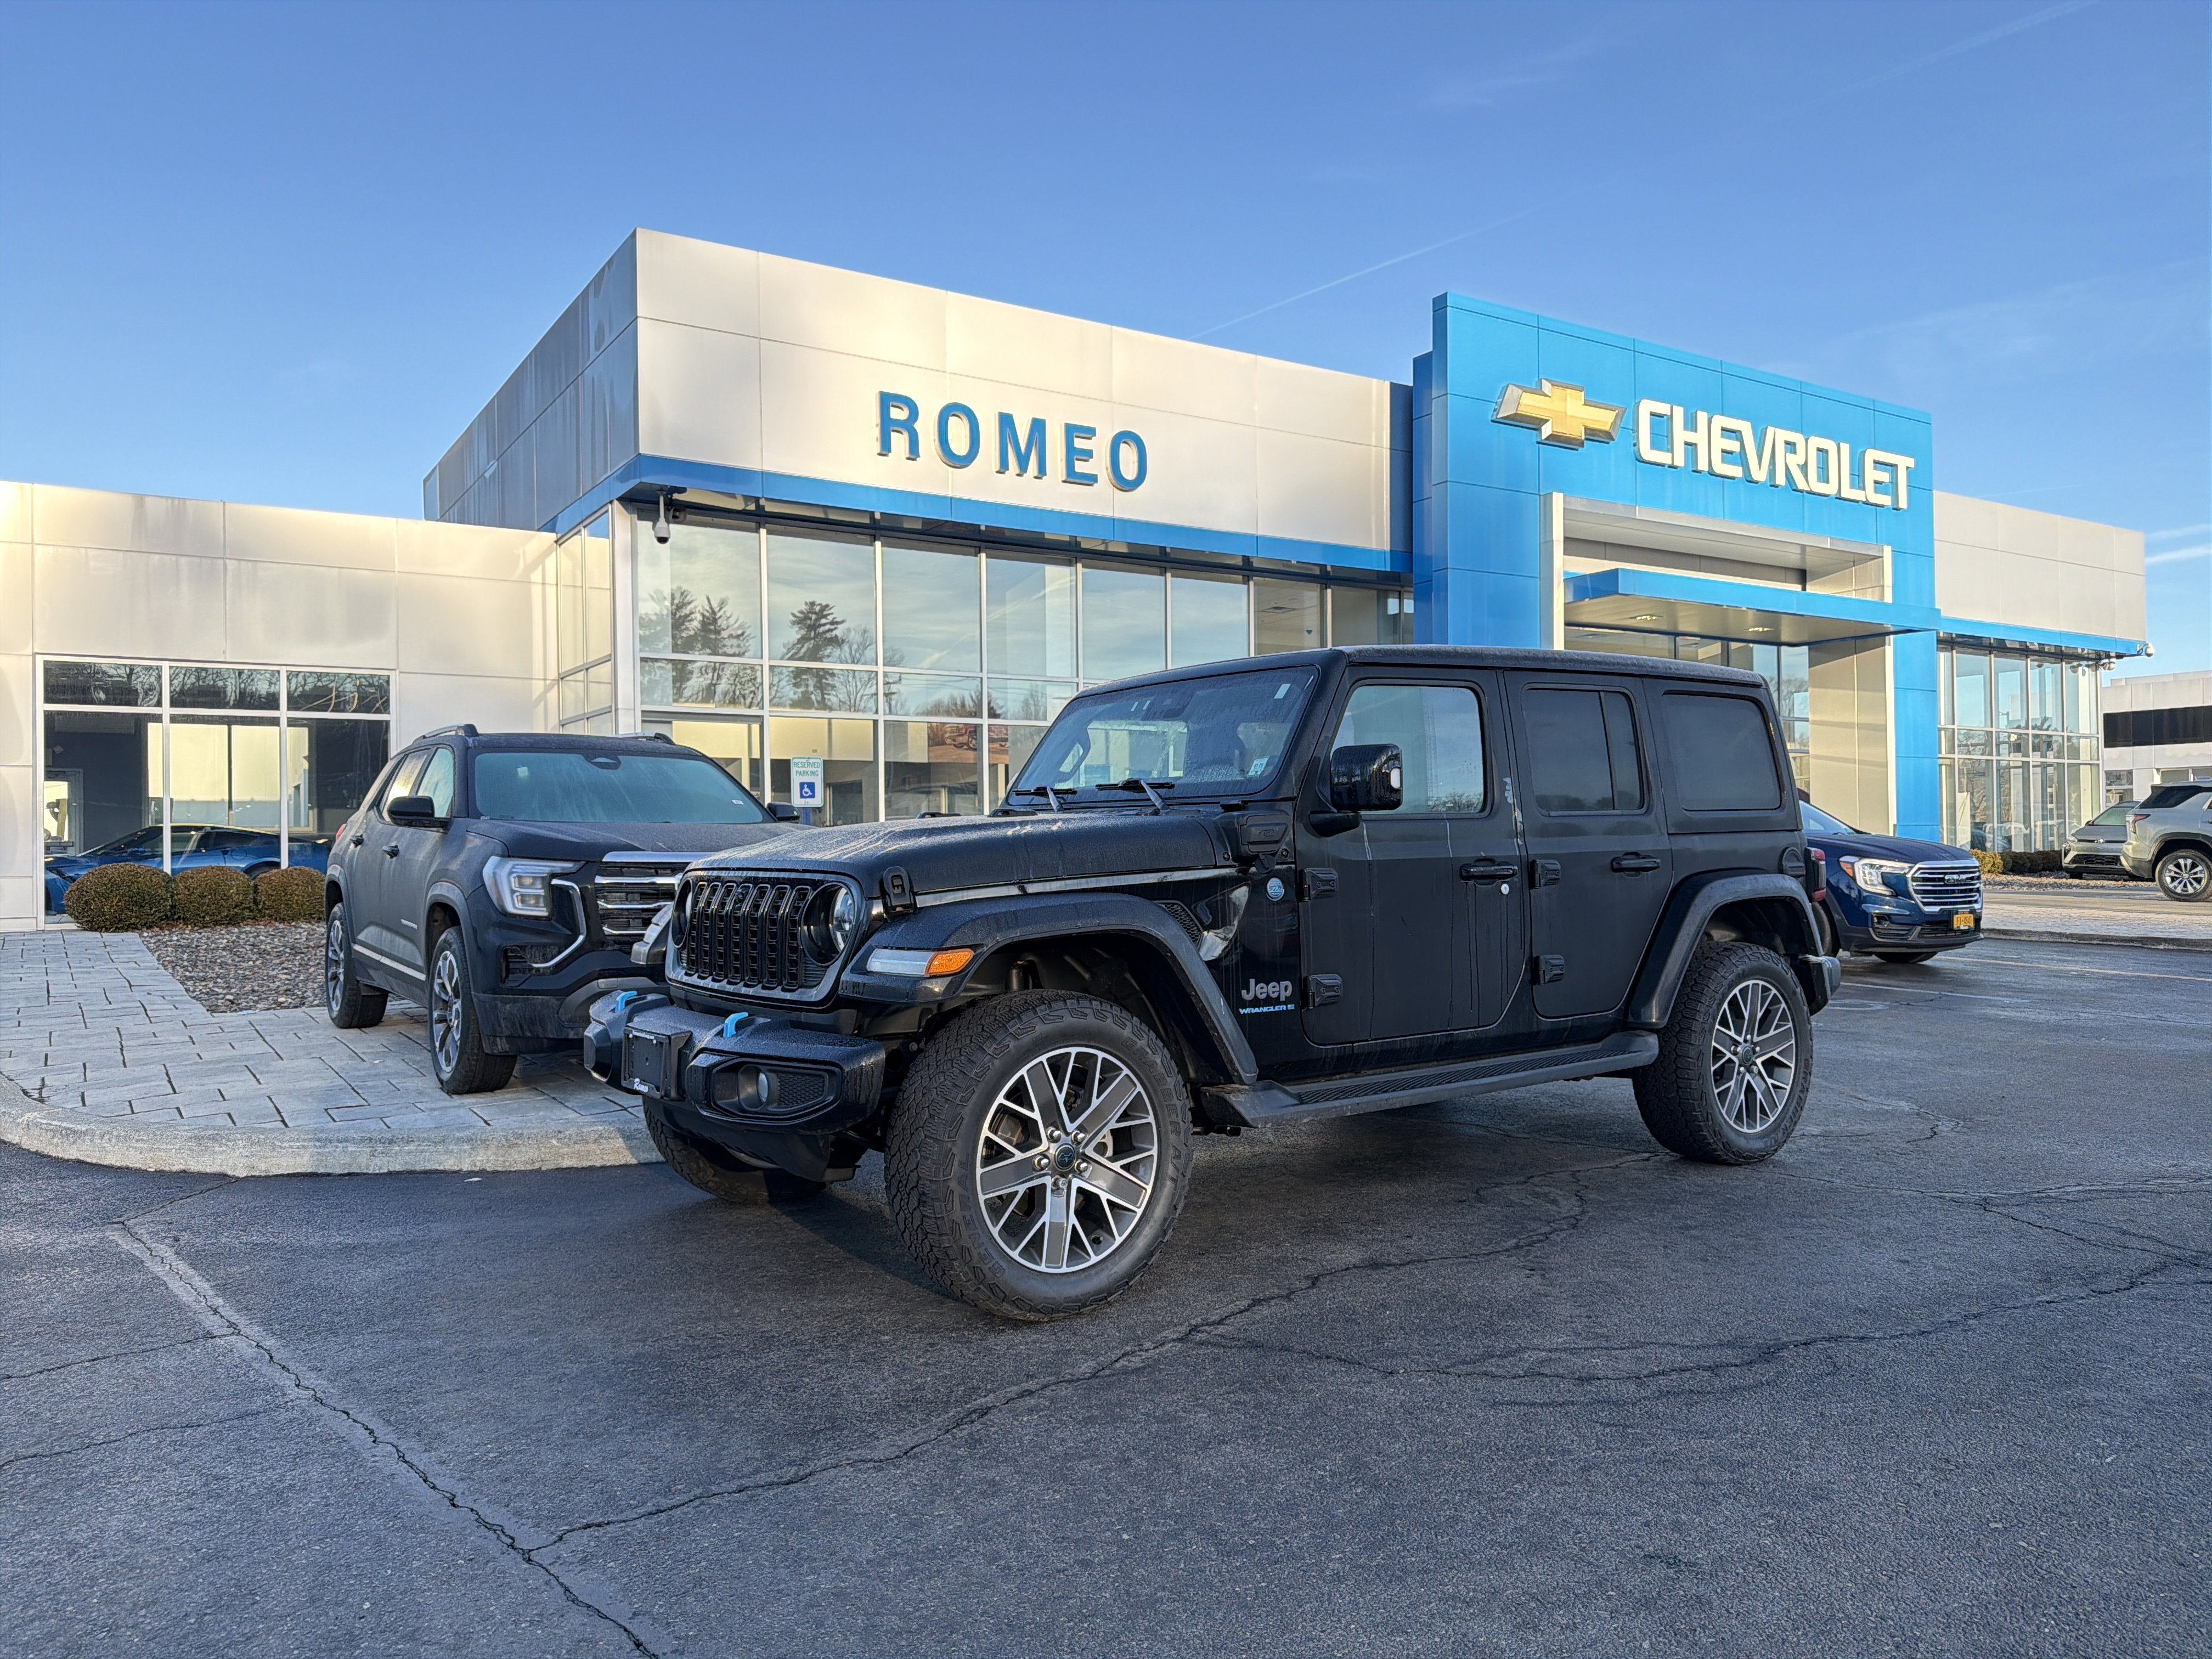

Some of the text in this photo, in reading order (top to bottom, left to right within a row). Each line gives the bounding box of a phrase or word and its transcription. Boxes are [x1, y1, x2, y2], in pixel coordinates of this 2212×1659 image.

[877, 391, 1148, 492] ROMEO
[1635, 398, 1915, 510] CHEVROLET
[1239, 1005, 1286, 1014] WRANGLER
[1242, 979, 1293, 1001] Jeep
[1122, 1036, 1181, 1137] GRABBER
[957, 1153, 1007, 1278] GENERAL
